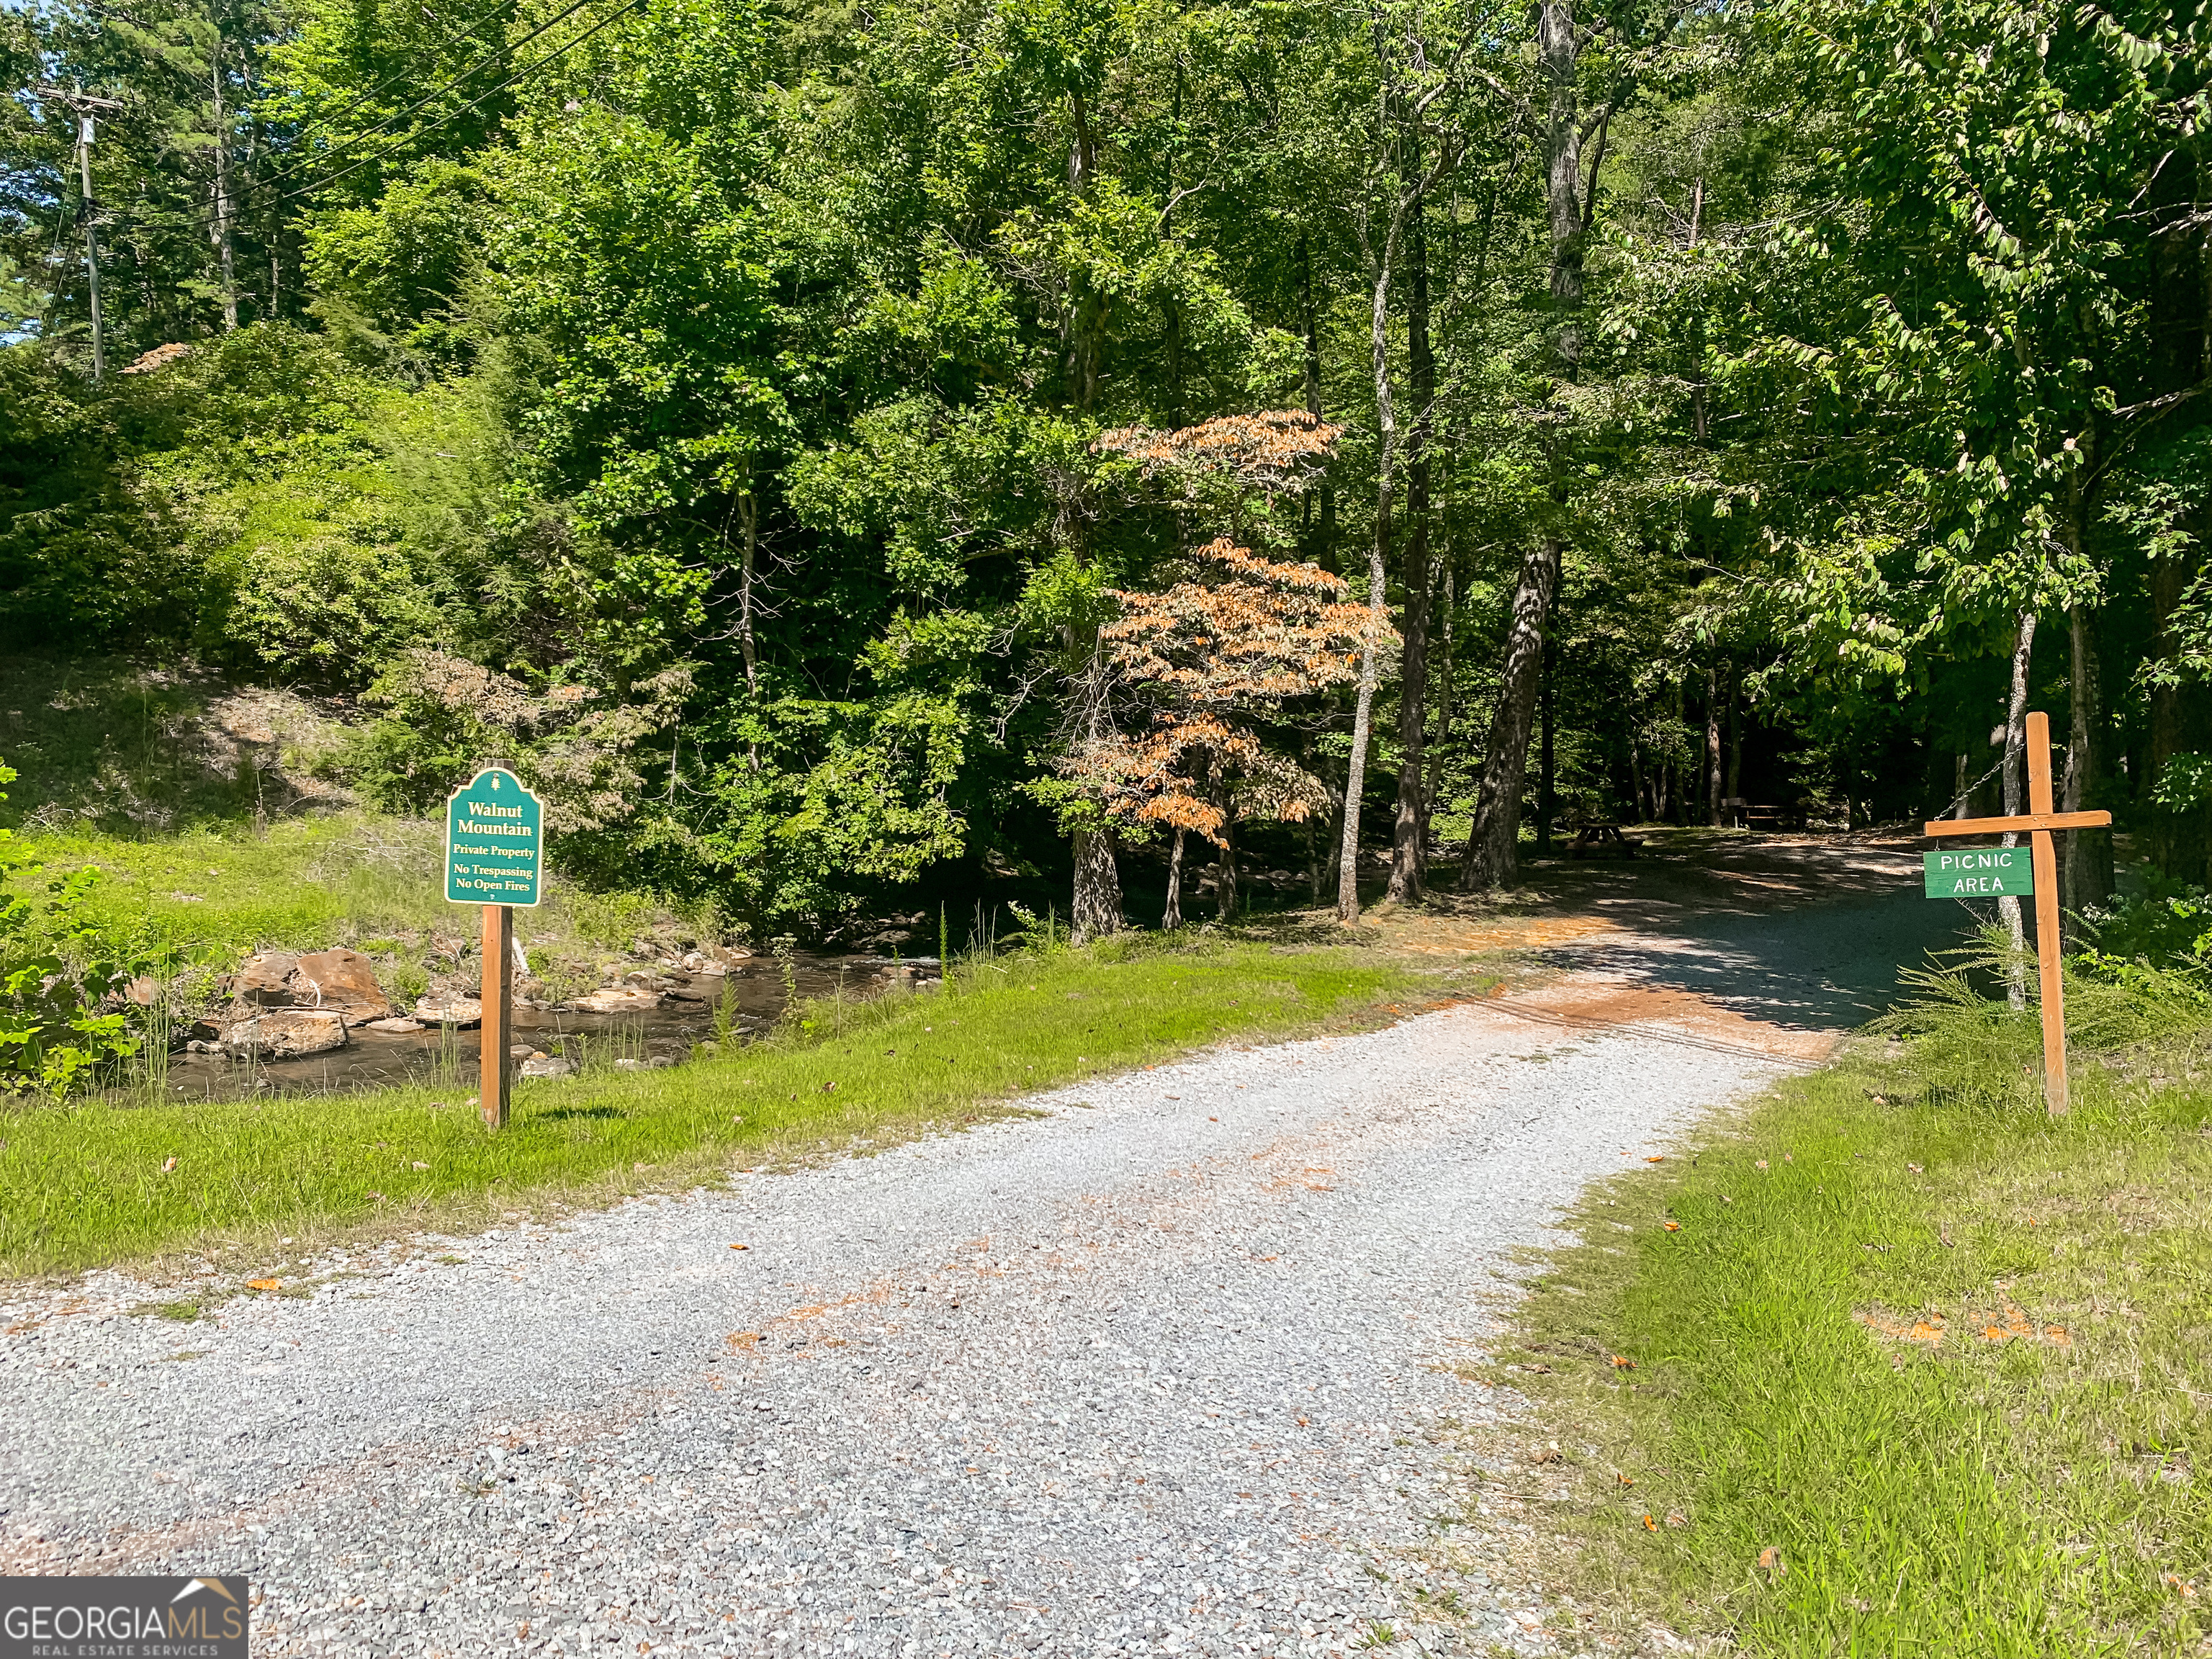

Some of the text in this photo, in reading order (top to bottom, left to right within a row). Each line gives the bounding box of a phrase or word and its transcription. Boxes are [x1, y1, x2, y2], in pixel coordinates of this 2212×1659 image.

[468, 801, 523, 818] Walnut
[457, 819, 532, 836] Mountain
[453, 844, 535, 860] Private Property
[1941, 853, 2013, 870] PICNIC
[454, 863, 534, 880] No Trespassing
[456, 878, 530, 891] No Open Fires
[1953, 876, 2004, 893] AREA
